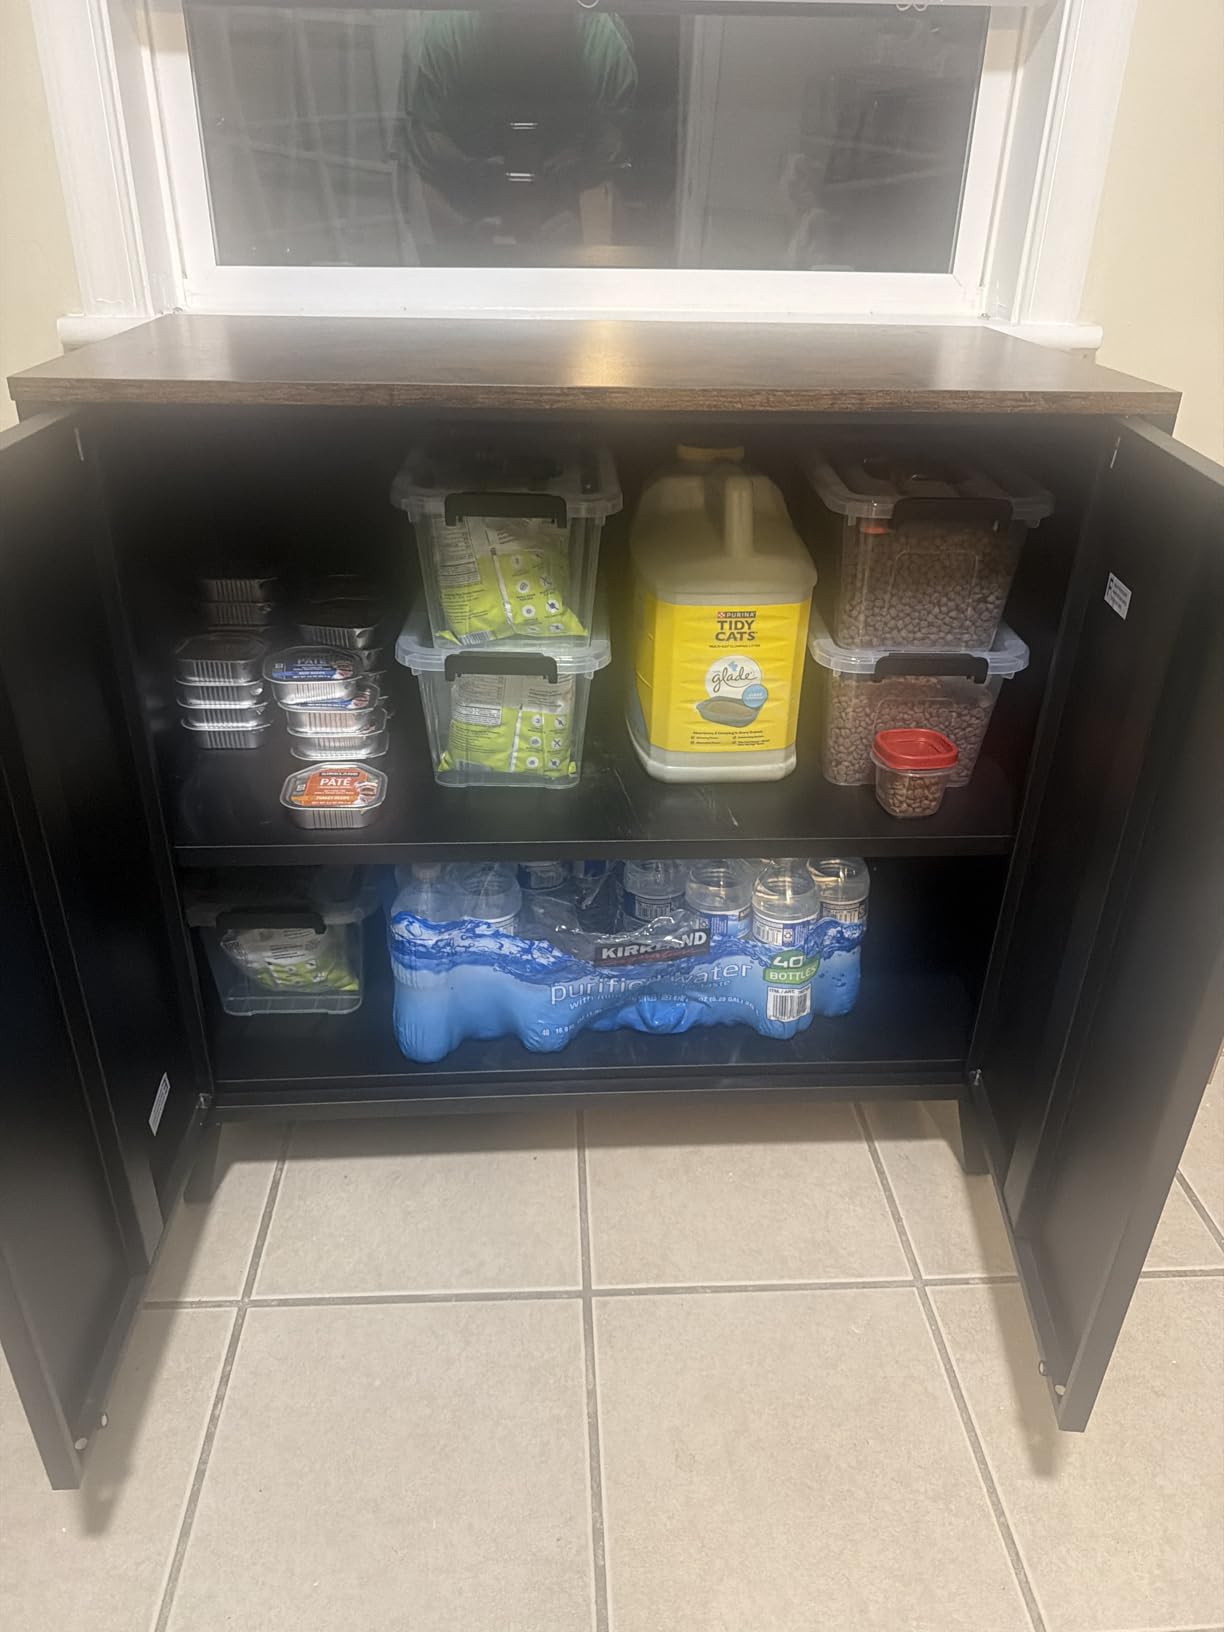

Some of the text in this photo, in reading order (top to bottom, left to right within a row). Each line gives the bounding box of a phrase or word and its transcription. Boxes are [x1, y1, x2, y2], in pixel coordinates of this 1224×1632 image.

[716, 620, 755, 631] TIDY
[715, 631, 757, 641] CATS
[712, 666, 758, 693] glade
[319, 777, 352, 786] PÂTÉ
[773, 956, 803, 968] 40
[769, 966, 816, 981] BOTTLES
[551, 976, 660, 1005] purifie
[671, 964, 753, 984] water
